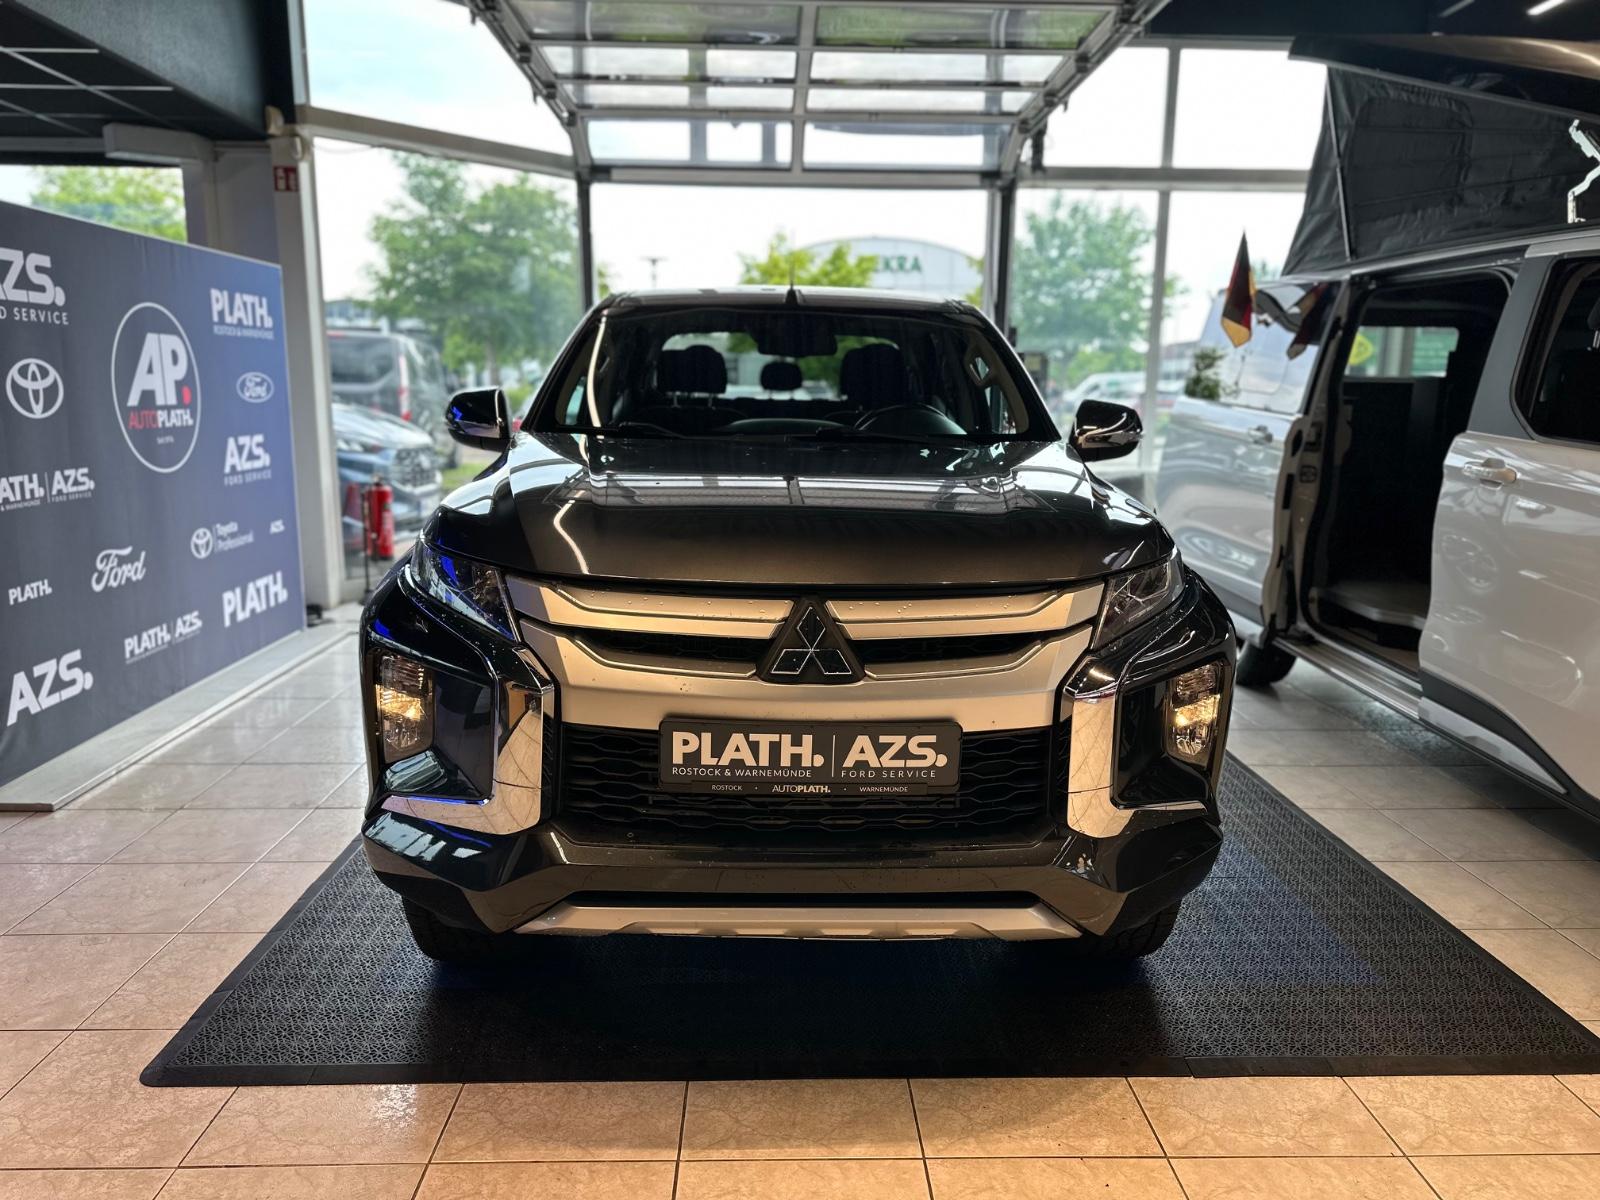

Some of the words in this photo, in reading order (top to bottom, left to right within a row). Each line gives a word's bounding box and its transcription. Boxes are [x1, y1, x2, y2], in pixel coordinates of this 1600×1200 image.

[0, 247, 66, 307] ZS.
[13, 306, 69, 325] SERVICE
[210, 287, 273, 329] PLATH.
[127, 332, 192, 407] AP.
[244, 376, 268, 398] Ford
[224, 433, 271, 474] AZS.
[51, 466, 96, 496] AZS.
[90, 545, 146, 593] Ford
[8, 578, 53, 605] PLATH.
[222, 570, 289, 628] PLATH.
[124, 622, 171, 660] PLATH.
[7, 648, 94, 727] AZS.
[672, 731, 825, 767] PLATH.
[842, 734, 948, 768] AZS.
[672, 767, 721, 776] ROSTOCK
[725, 768, 732, 776] &
[735, 767, 812, 778] WARNEMÜNDE
[772, 784, 831, 793] AUTOPLATH.
[841, 770, 876, 778] FORD
[882, 770, 936, 778] SERVICE
